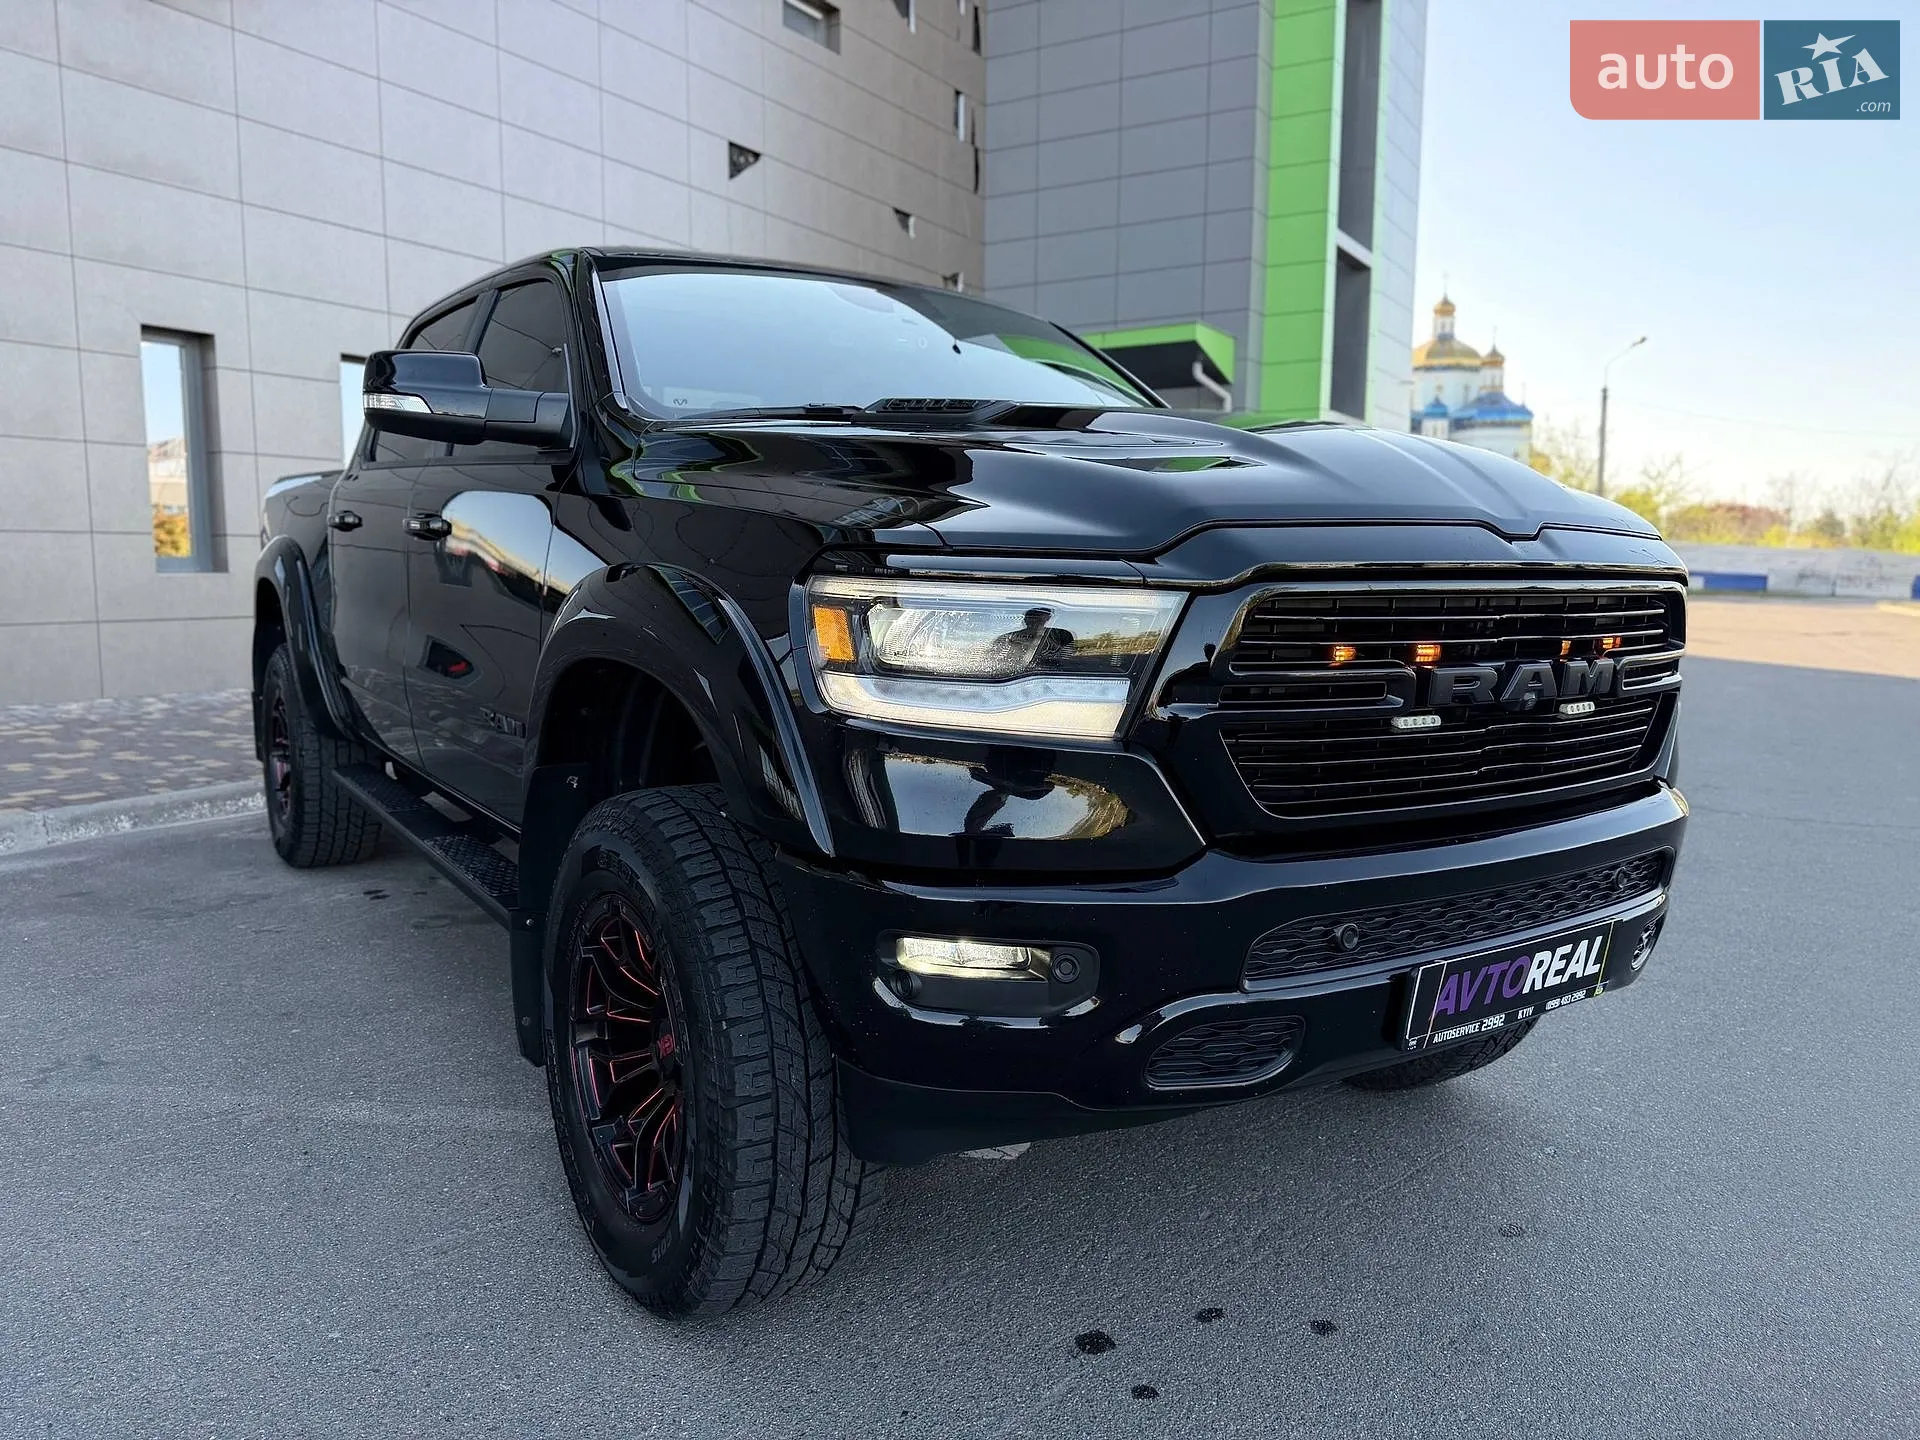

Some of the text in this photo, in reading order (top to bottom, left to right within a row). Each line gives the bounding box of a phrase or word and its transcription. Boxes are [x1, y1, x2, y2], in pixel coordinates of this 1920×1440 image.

[1428, 658, 1614, 707] RAM
[1433, 1022, 1480, 1044] AUTOSERVICE
[1481, 1014, 1505, 1032] 2992
[1517, 1006, 1534, 1020] KYIV
